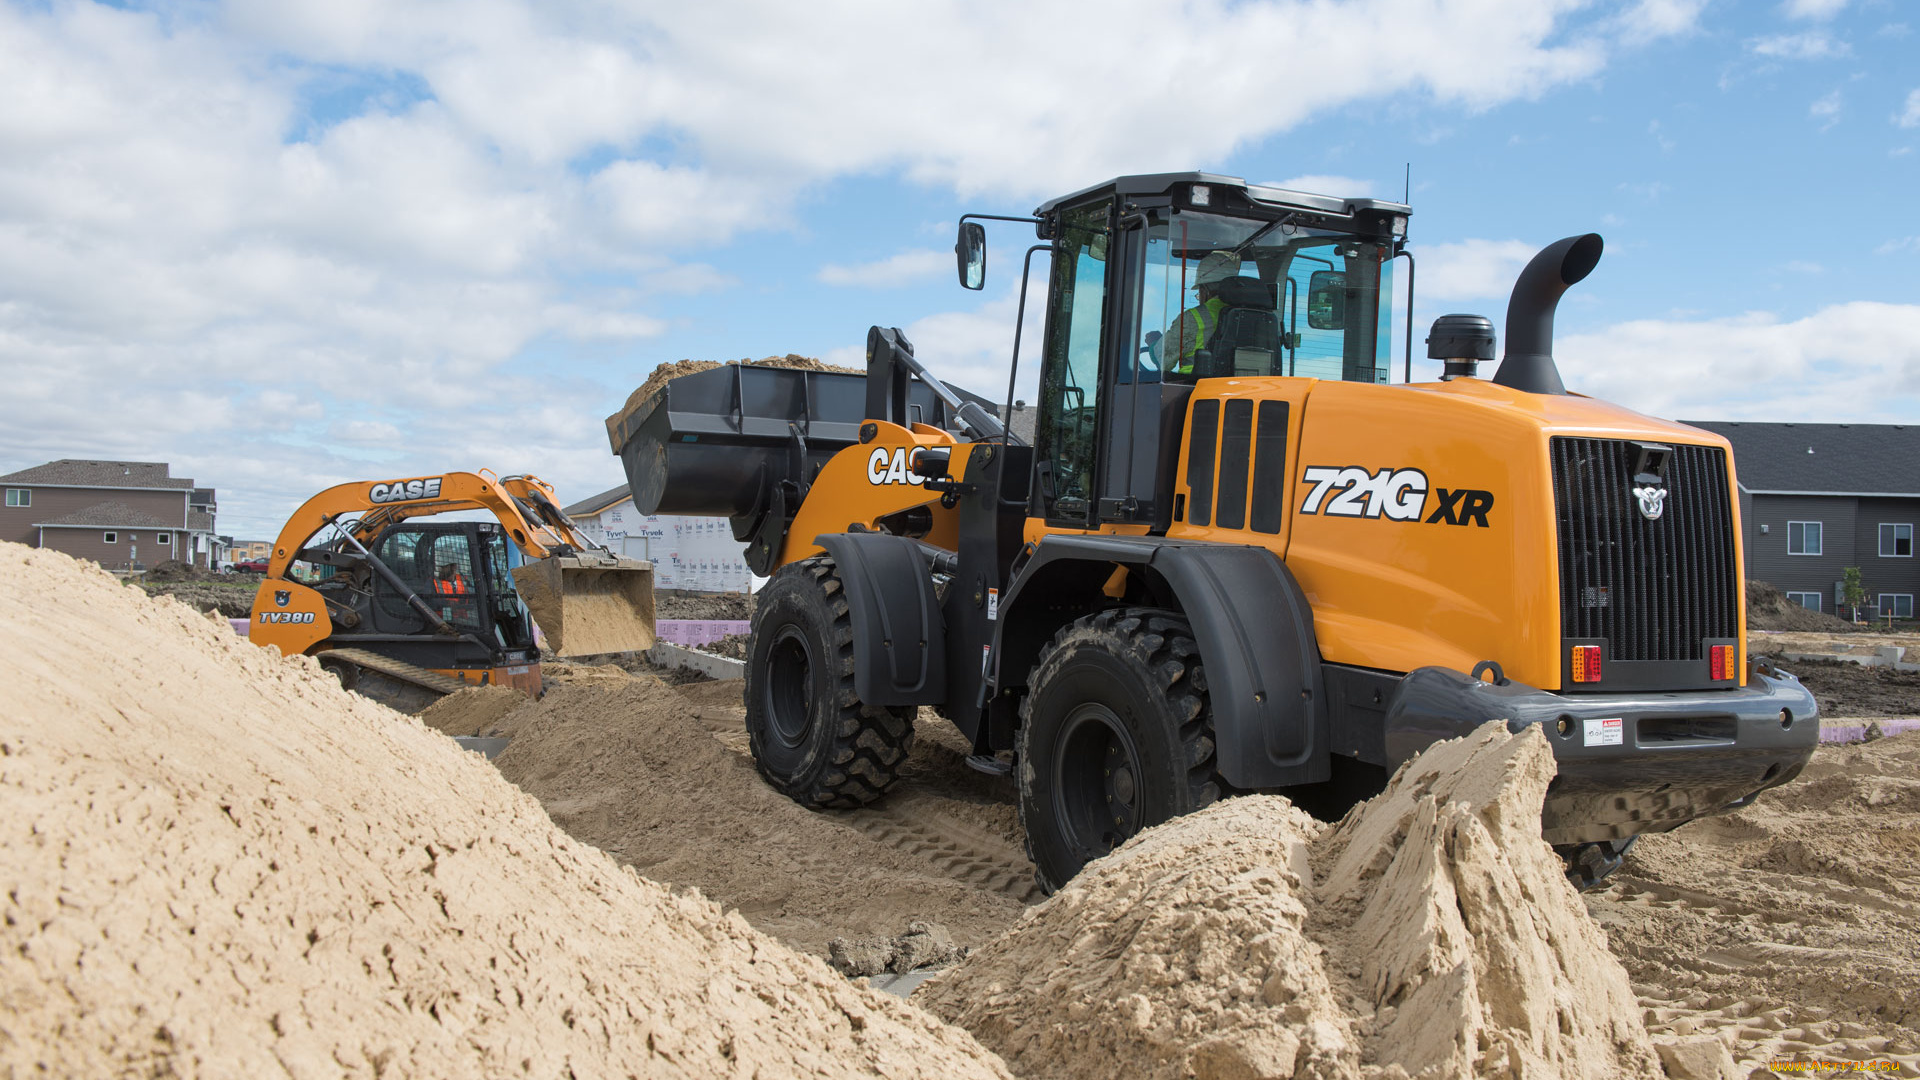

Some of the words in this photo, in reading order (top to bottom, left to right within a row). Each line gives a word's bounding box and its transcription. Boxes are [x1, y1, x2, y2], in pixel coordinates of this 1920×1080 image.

[868, 446, 952, 486] CAS
[369, 477, 442, 503] CASE
[1300, 465, 1429, 522] 721G
[1425, 488, 1494, 528] XR
[260, 612, 315, 624] TV380
